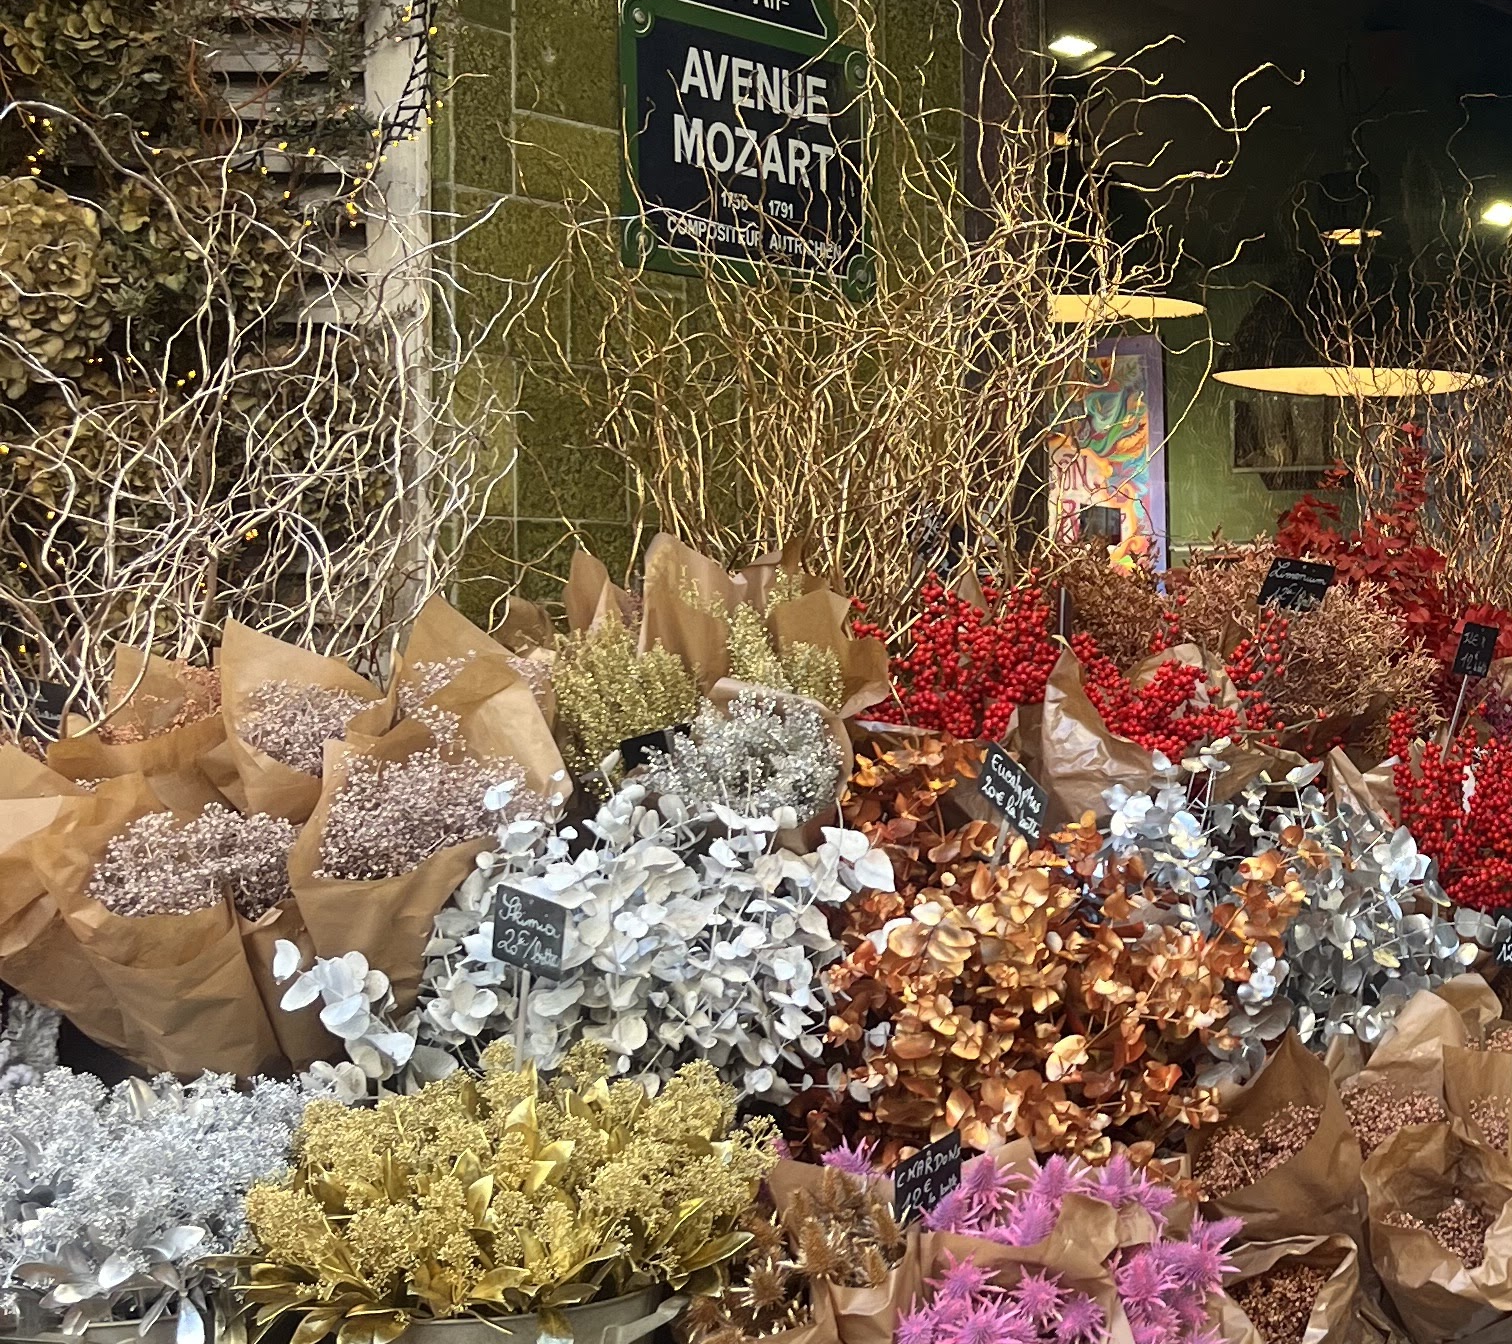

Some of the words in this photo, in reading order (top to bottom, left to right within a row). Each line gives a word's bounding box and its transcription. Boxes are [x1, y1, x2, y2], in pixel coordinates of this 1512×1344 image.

[680, 46, 829, 126] AVENUE
[672, 113, 834, 191] MOZART
[768, 199, 795, 220] 1791
[769, 233, 842, 260] AUTRCHIEN
[896, 1143, 961, 1188] CHARDONS
